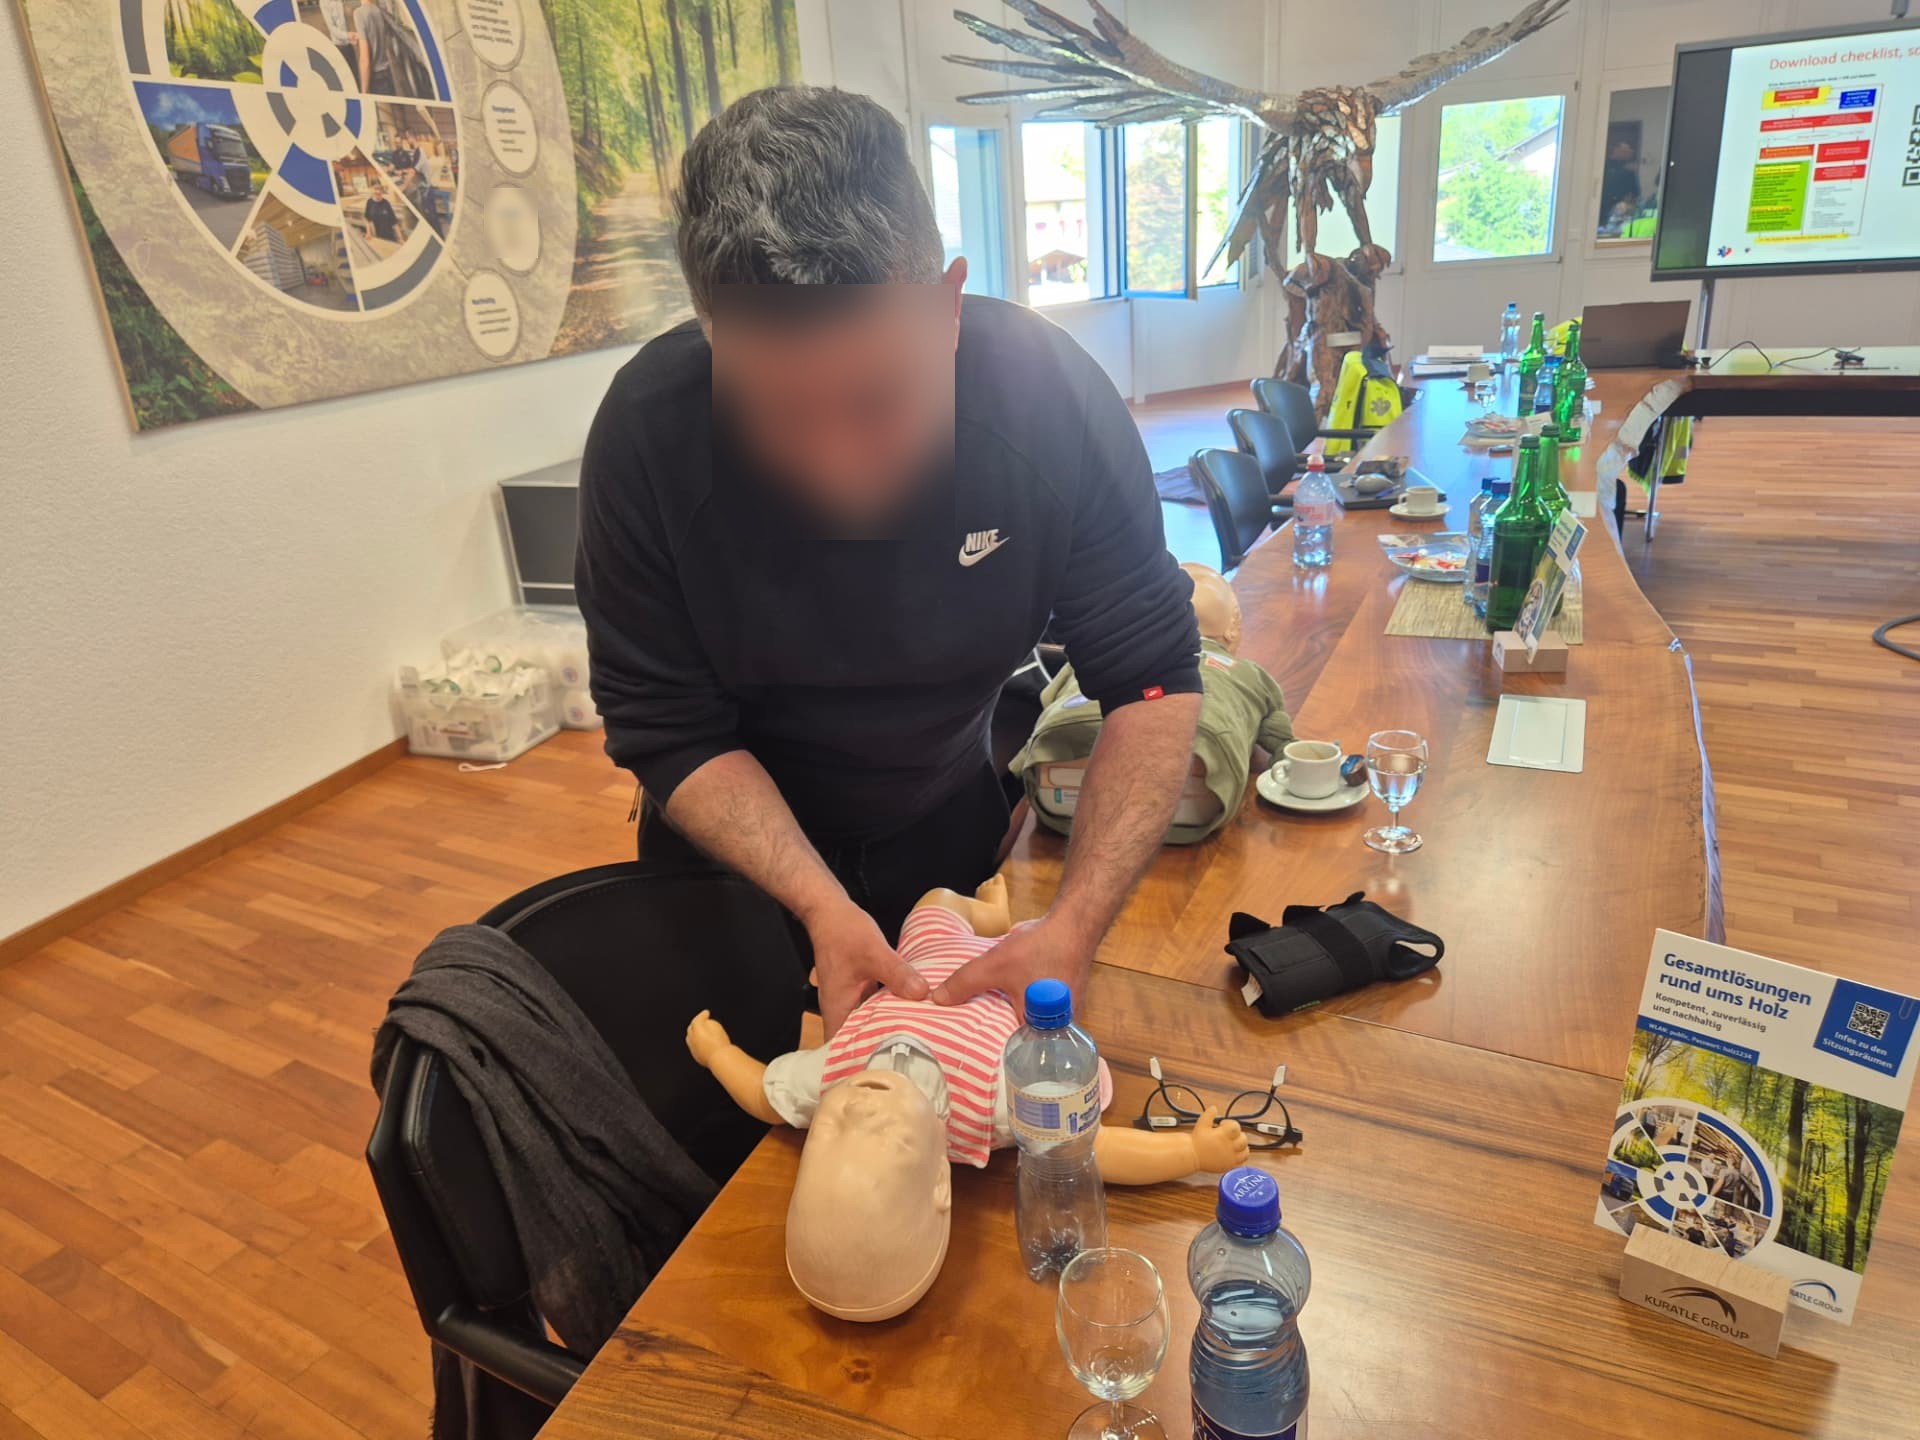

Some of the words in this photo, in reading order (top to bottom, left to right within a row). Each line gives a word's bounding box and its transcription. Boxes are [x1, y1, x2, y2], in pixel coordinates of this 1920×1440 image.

[1769, 52, 1837, 70] Download
[1841, 47, 1903, 63] checklist,
[965, 528, 1000, 552] NIKE
[1664, 953, 1812, 1006] Gesamtlösungen
[1659, 973, 1702, 994] rund
[1706, 987, 1744, 1006] ums
[1748, 996, 1789, 1020] Holz
[1653, 1003, 1671, 1015] und
[1672, 1010, 1722, 1031] nachhaltig
[1655, 991, 1709, 1015] Kompetent,
[1711, 1009, 1767, 1033] zuverlässig
[1822, 1037, 1893, 1069] Sitzungsräumen
[1834, 1031, 1857, 1045] Infos
[1858, 1041, 1869, 1049] zu
[1870, 1045, 1888, 1056] den
[1234, 1174, 1268, 1201] ARKINA
[1644, 1294, 1698, 1323] KURATLE
[1700, 1316, 1750, 1341] GROUP
[1813, 1298, 1844, 1314] GROUP
